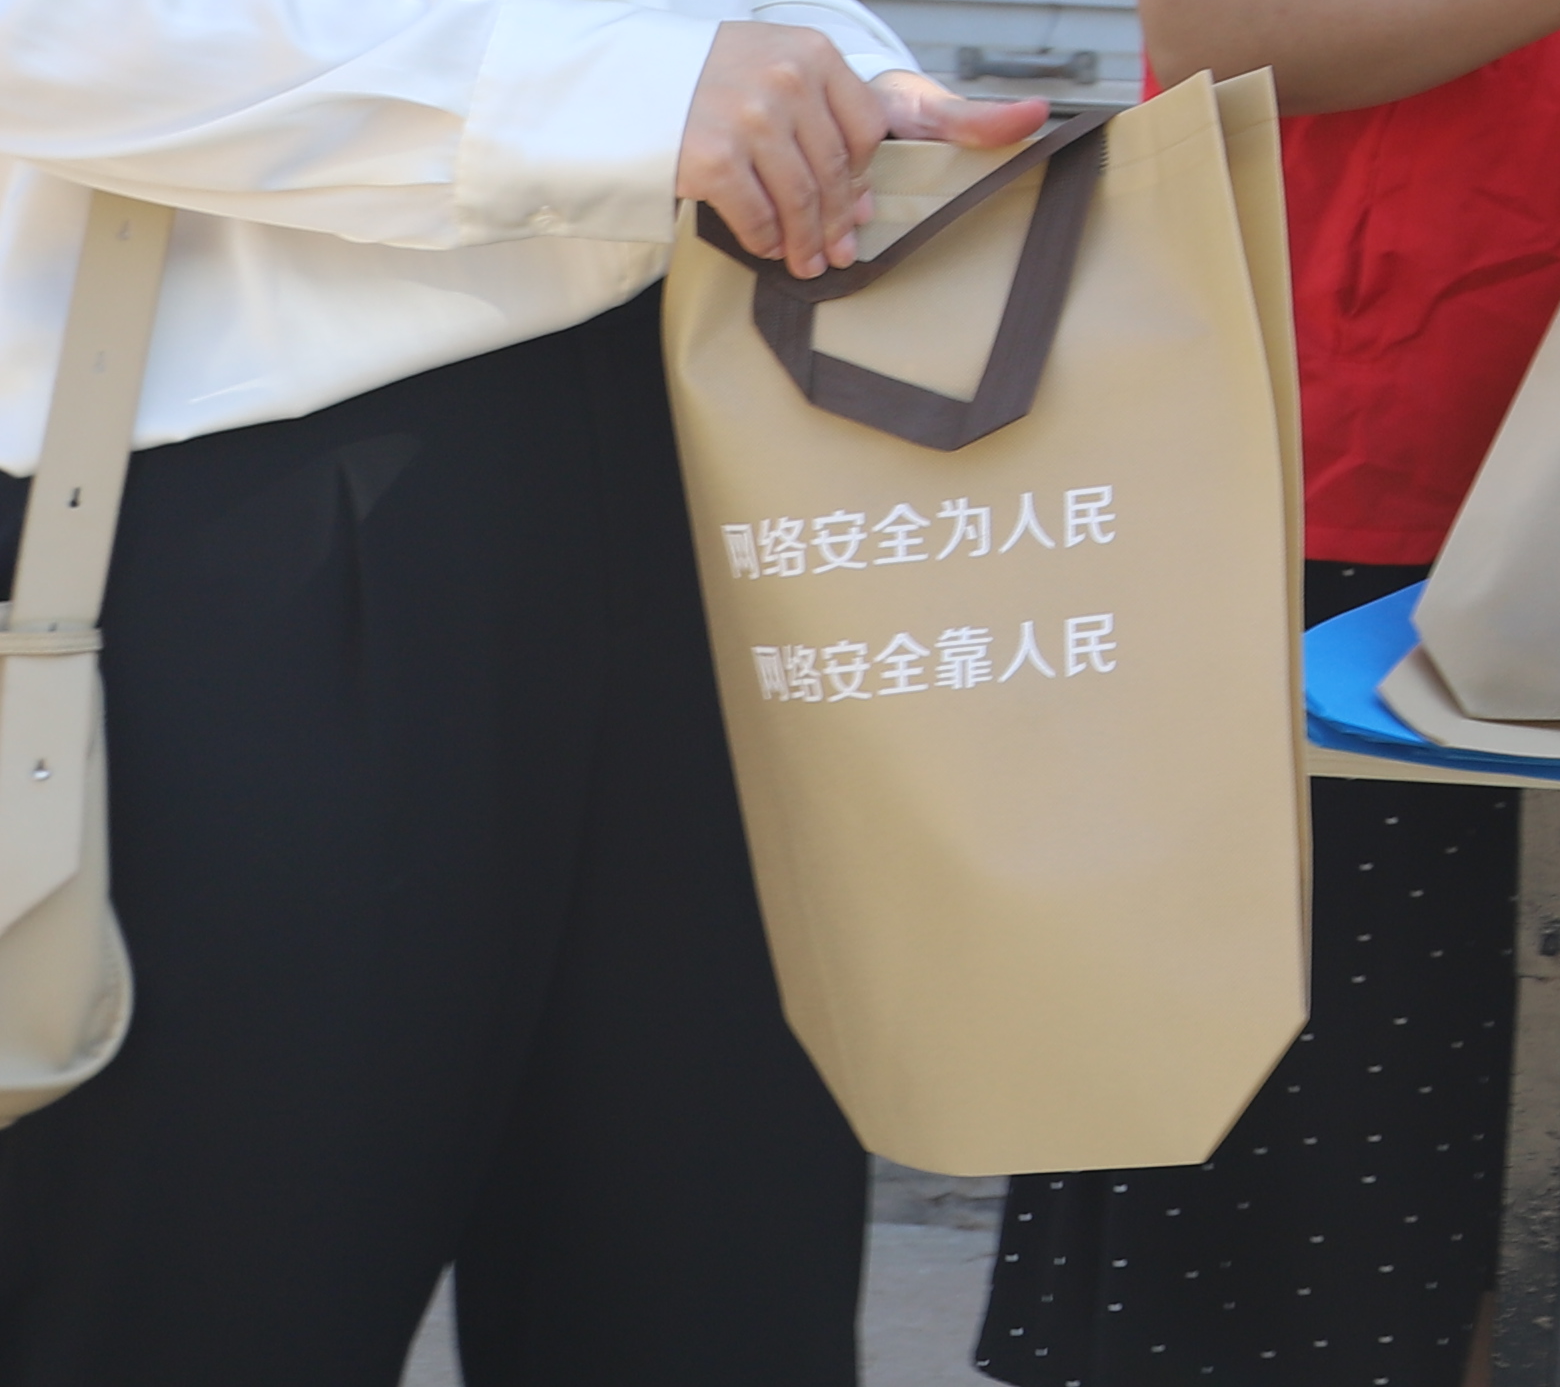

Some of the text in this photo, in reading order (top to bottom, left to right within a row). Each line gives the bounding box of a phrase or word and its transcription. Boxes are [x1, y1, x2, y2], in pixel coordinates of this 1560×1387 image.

[720, 484, 1118, 581] 网络安全为人民
[750, 612, 1119, 704] 网络安全靠人民
